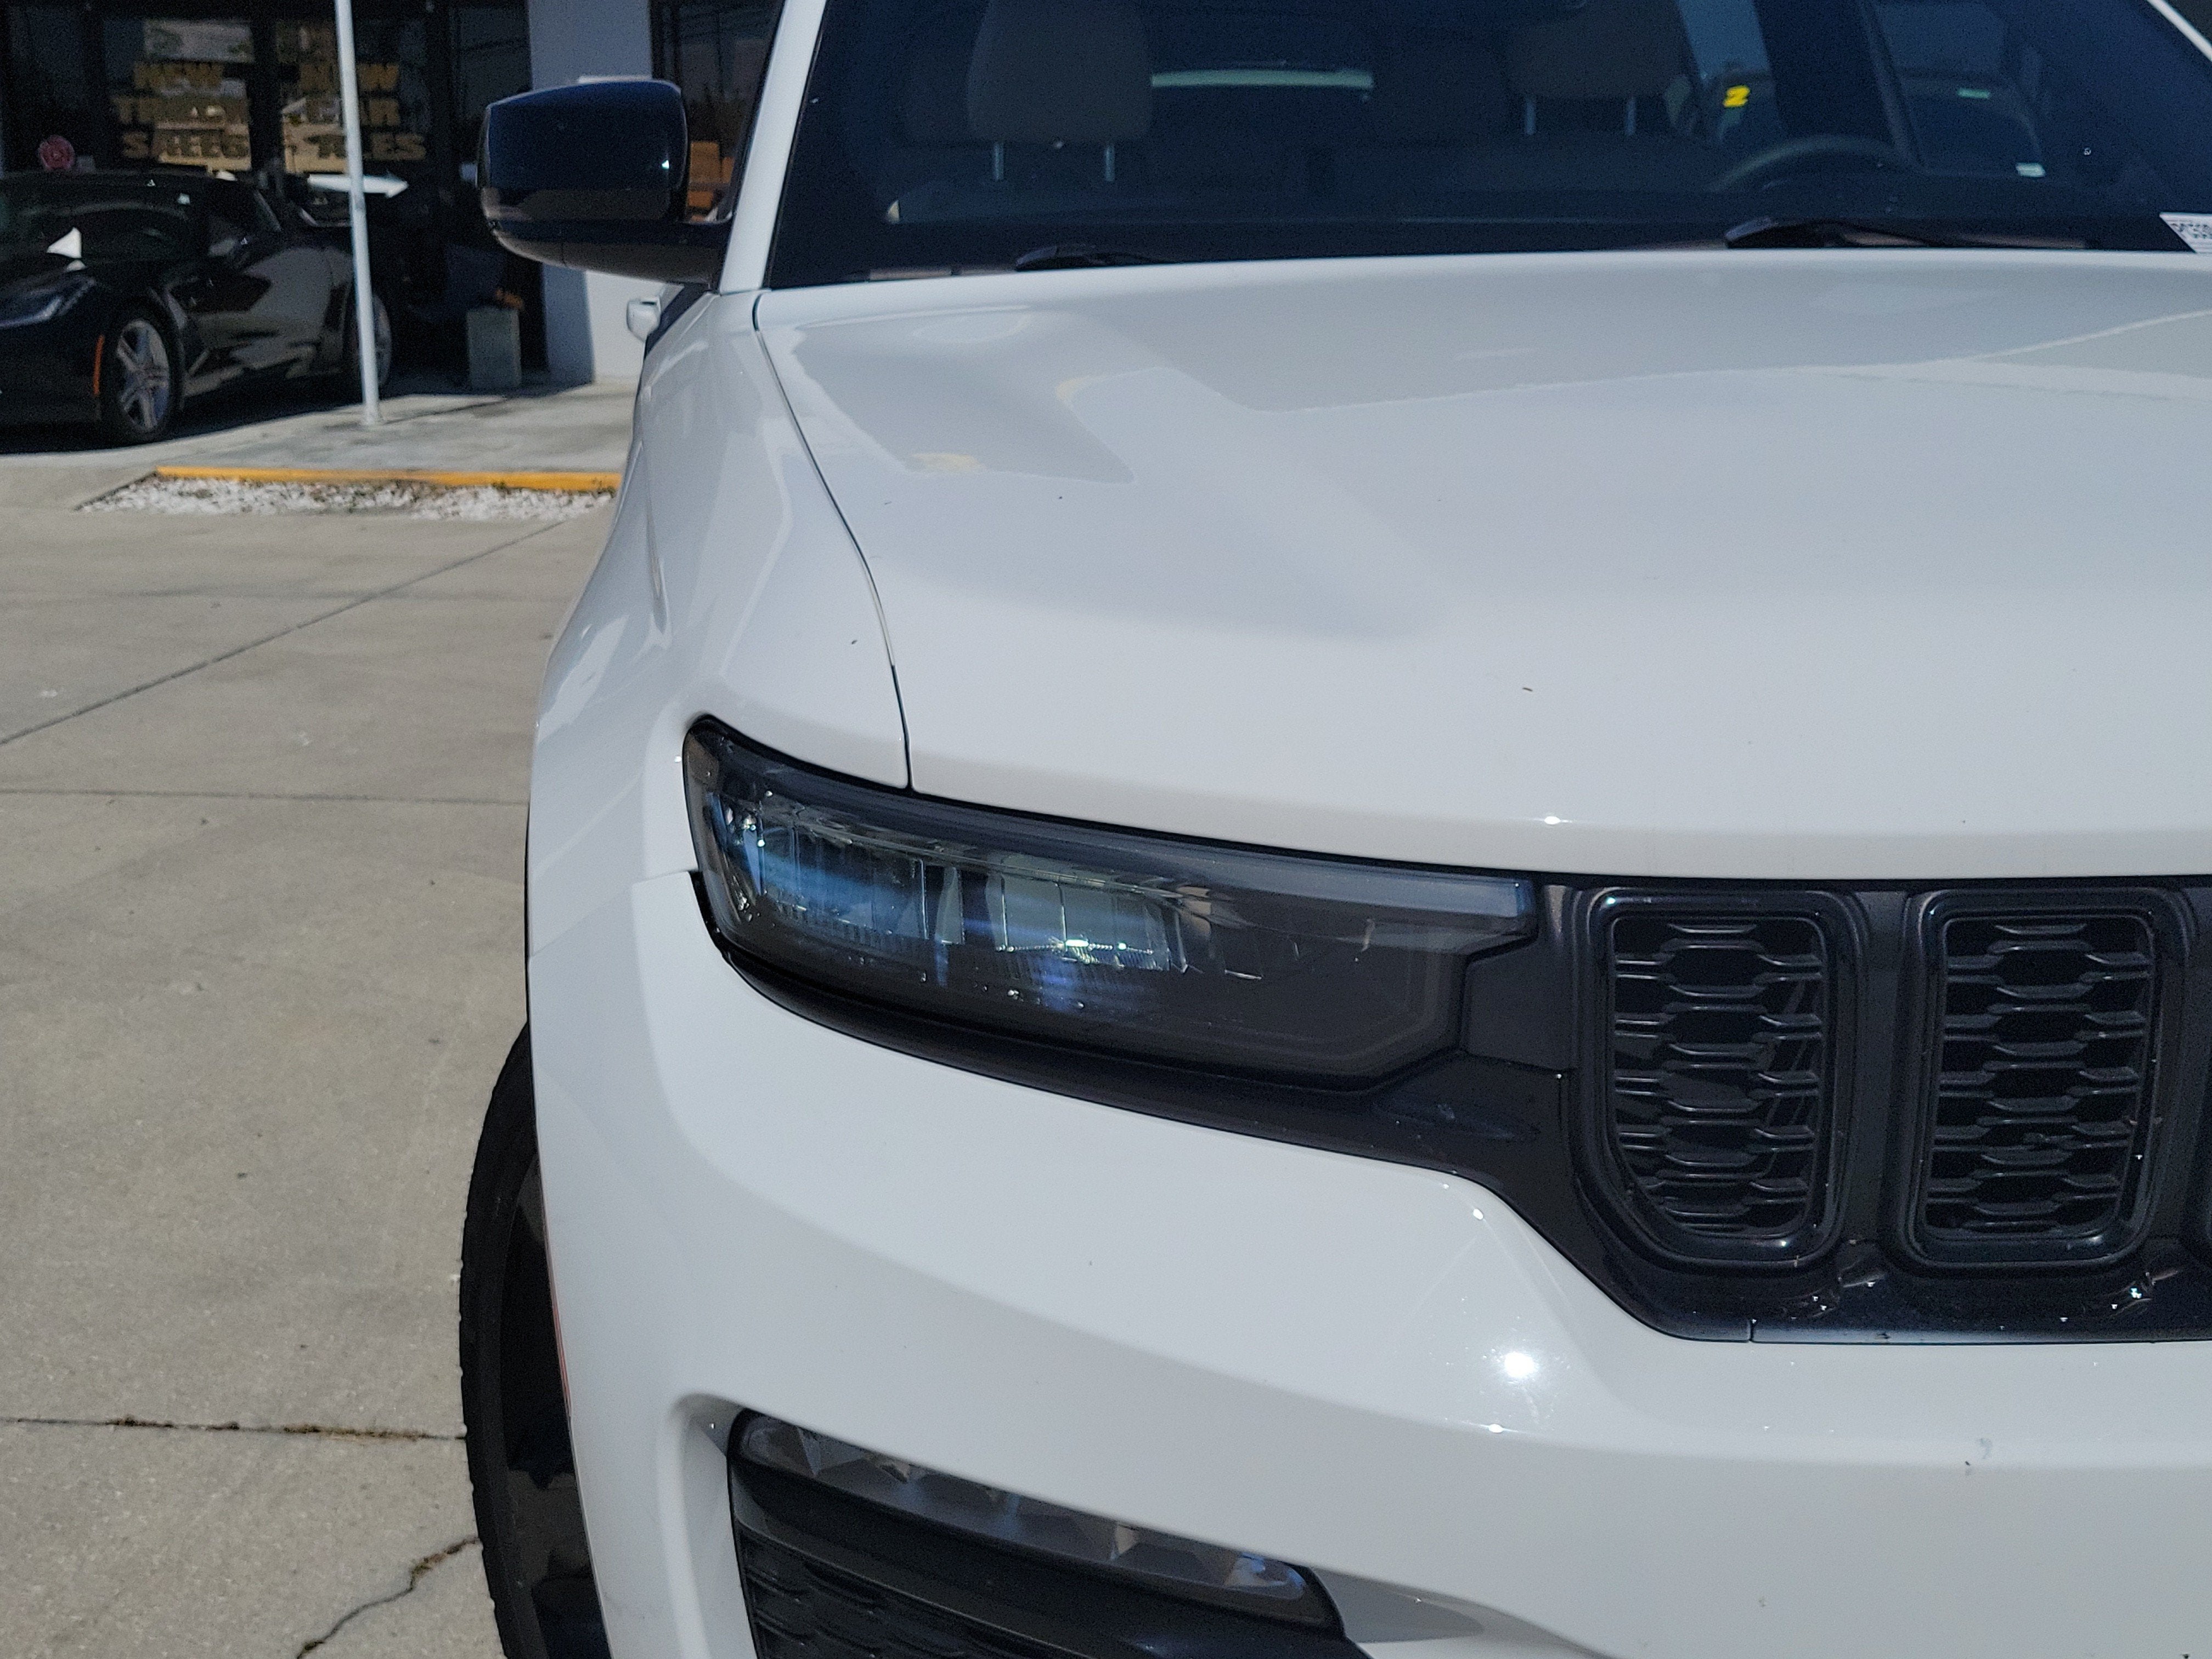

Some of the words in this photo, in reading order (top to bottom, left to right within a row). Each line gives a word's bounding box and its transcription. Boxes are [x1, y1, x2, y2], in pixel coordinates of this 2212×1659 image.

[299, 63, 400, 91] NW
[306, 97, 401, 126] CR
[292, 132, 426, 161] AES
